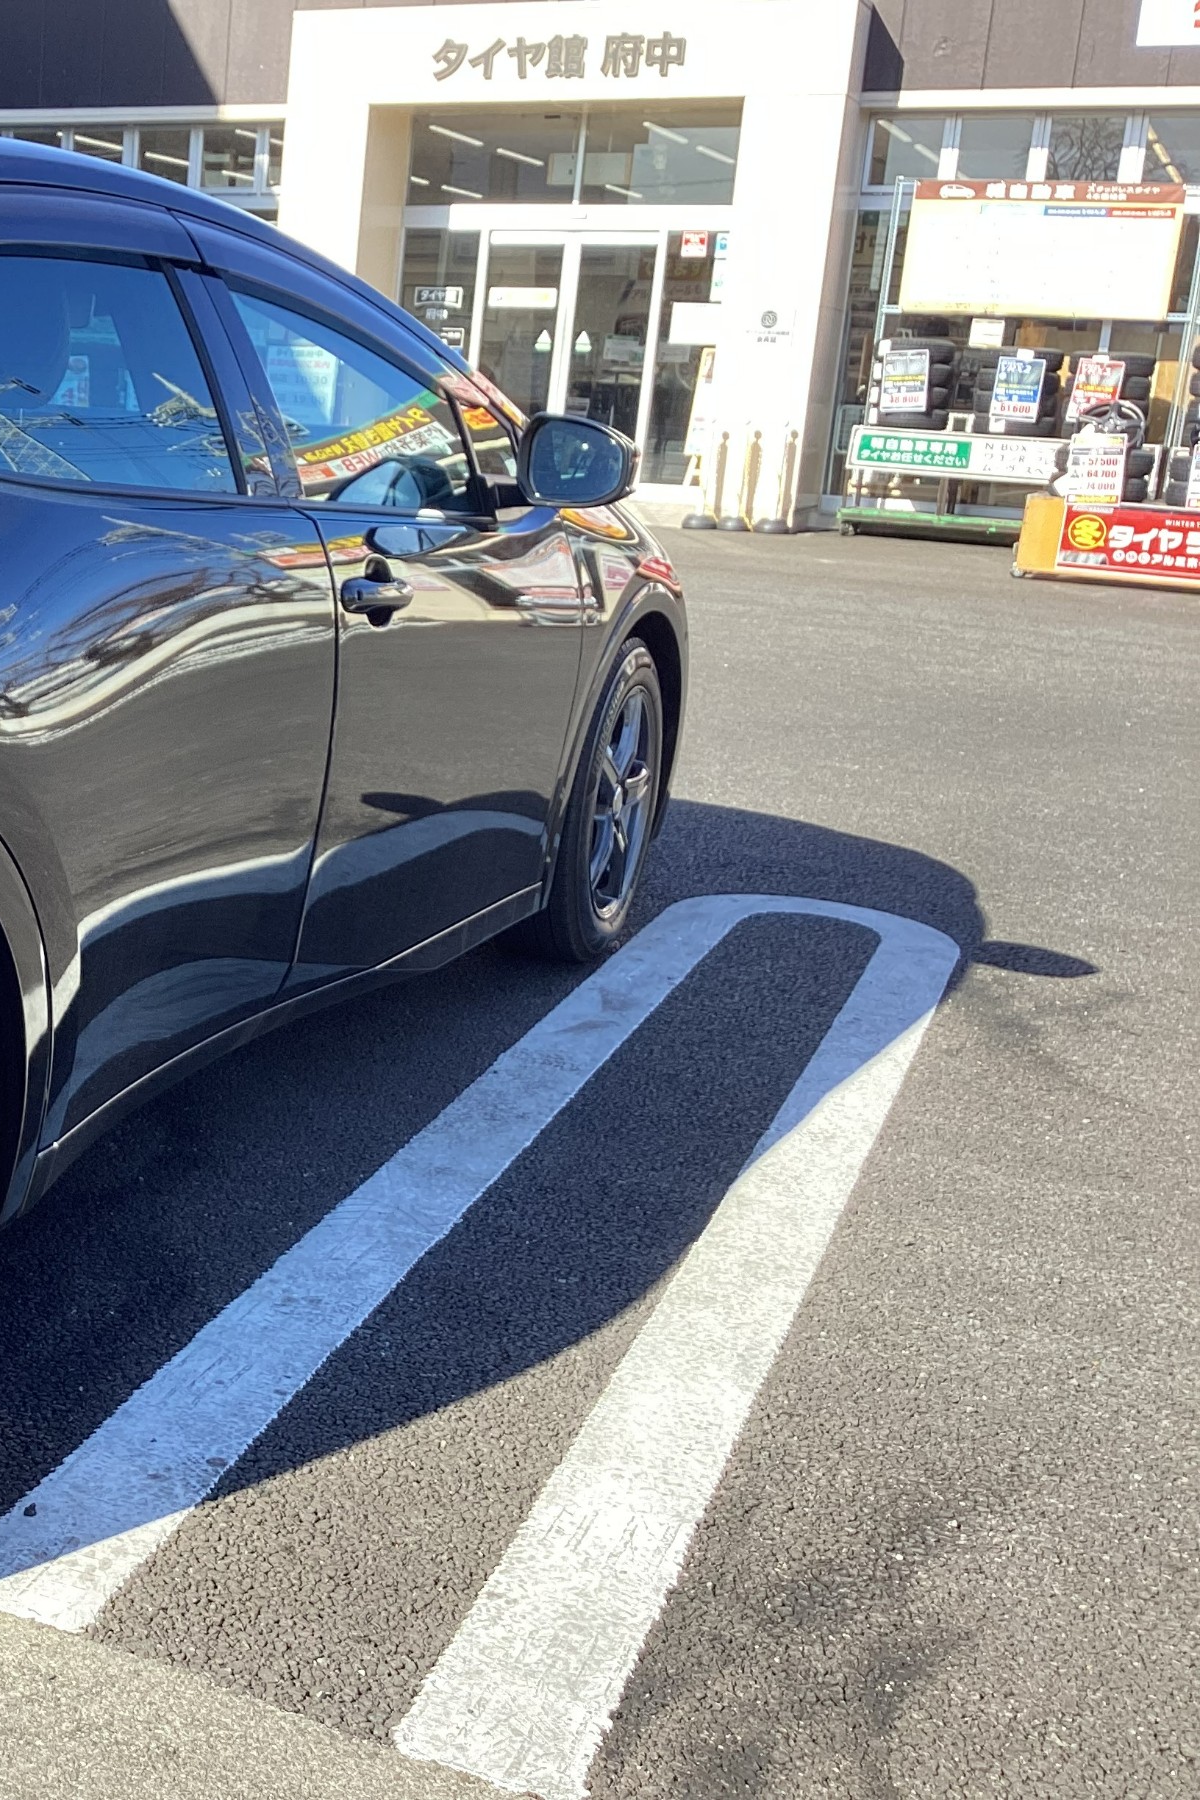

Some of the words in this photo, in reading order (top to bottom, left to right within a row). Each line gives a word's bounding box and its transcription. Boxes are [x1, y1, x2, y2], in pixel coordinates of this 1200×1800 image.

[432, 33, 588, 81] タイヤ館
[600, 31, 687, 78] 府中
[860, 449, 966, 466] タイヤお任せください
[1073, 519, 1101, 546] 冬
[1165, 519, 1195, 528] WINTER
